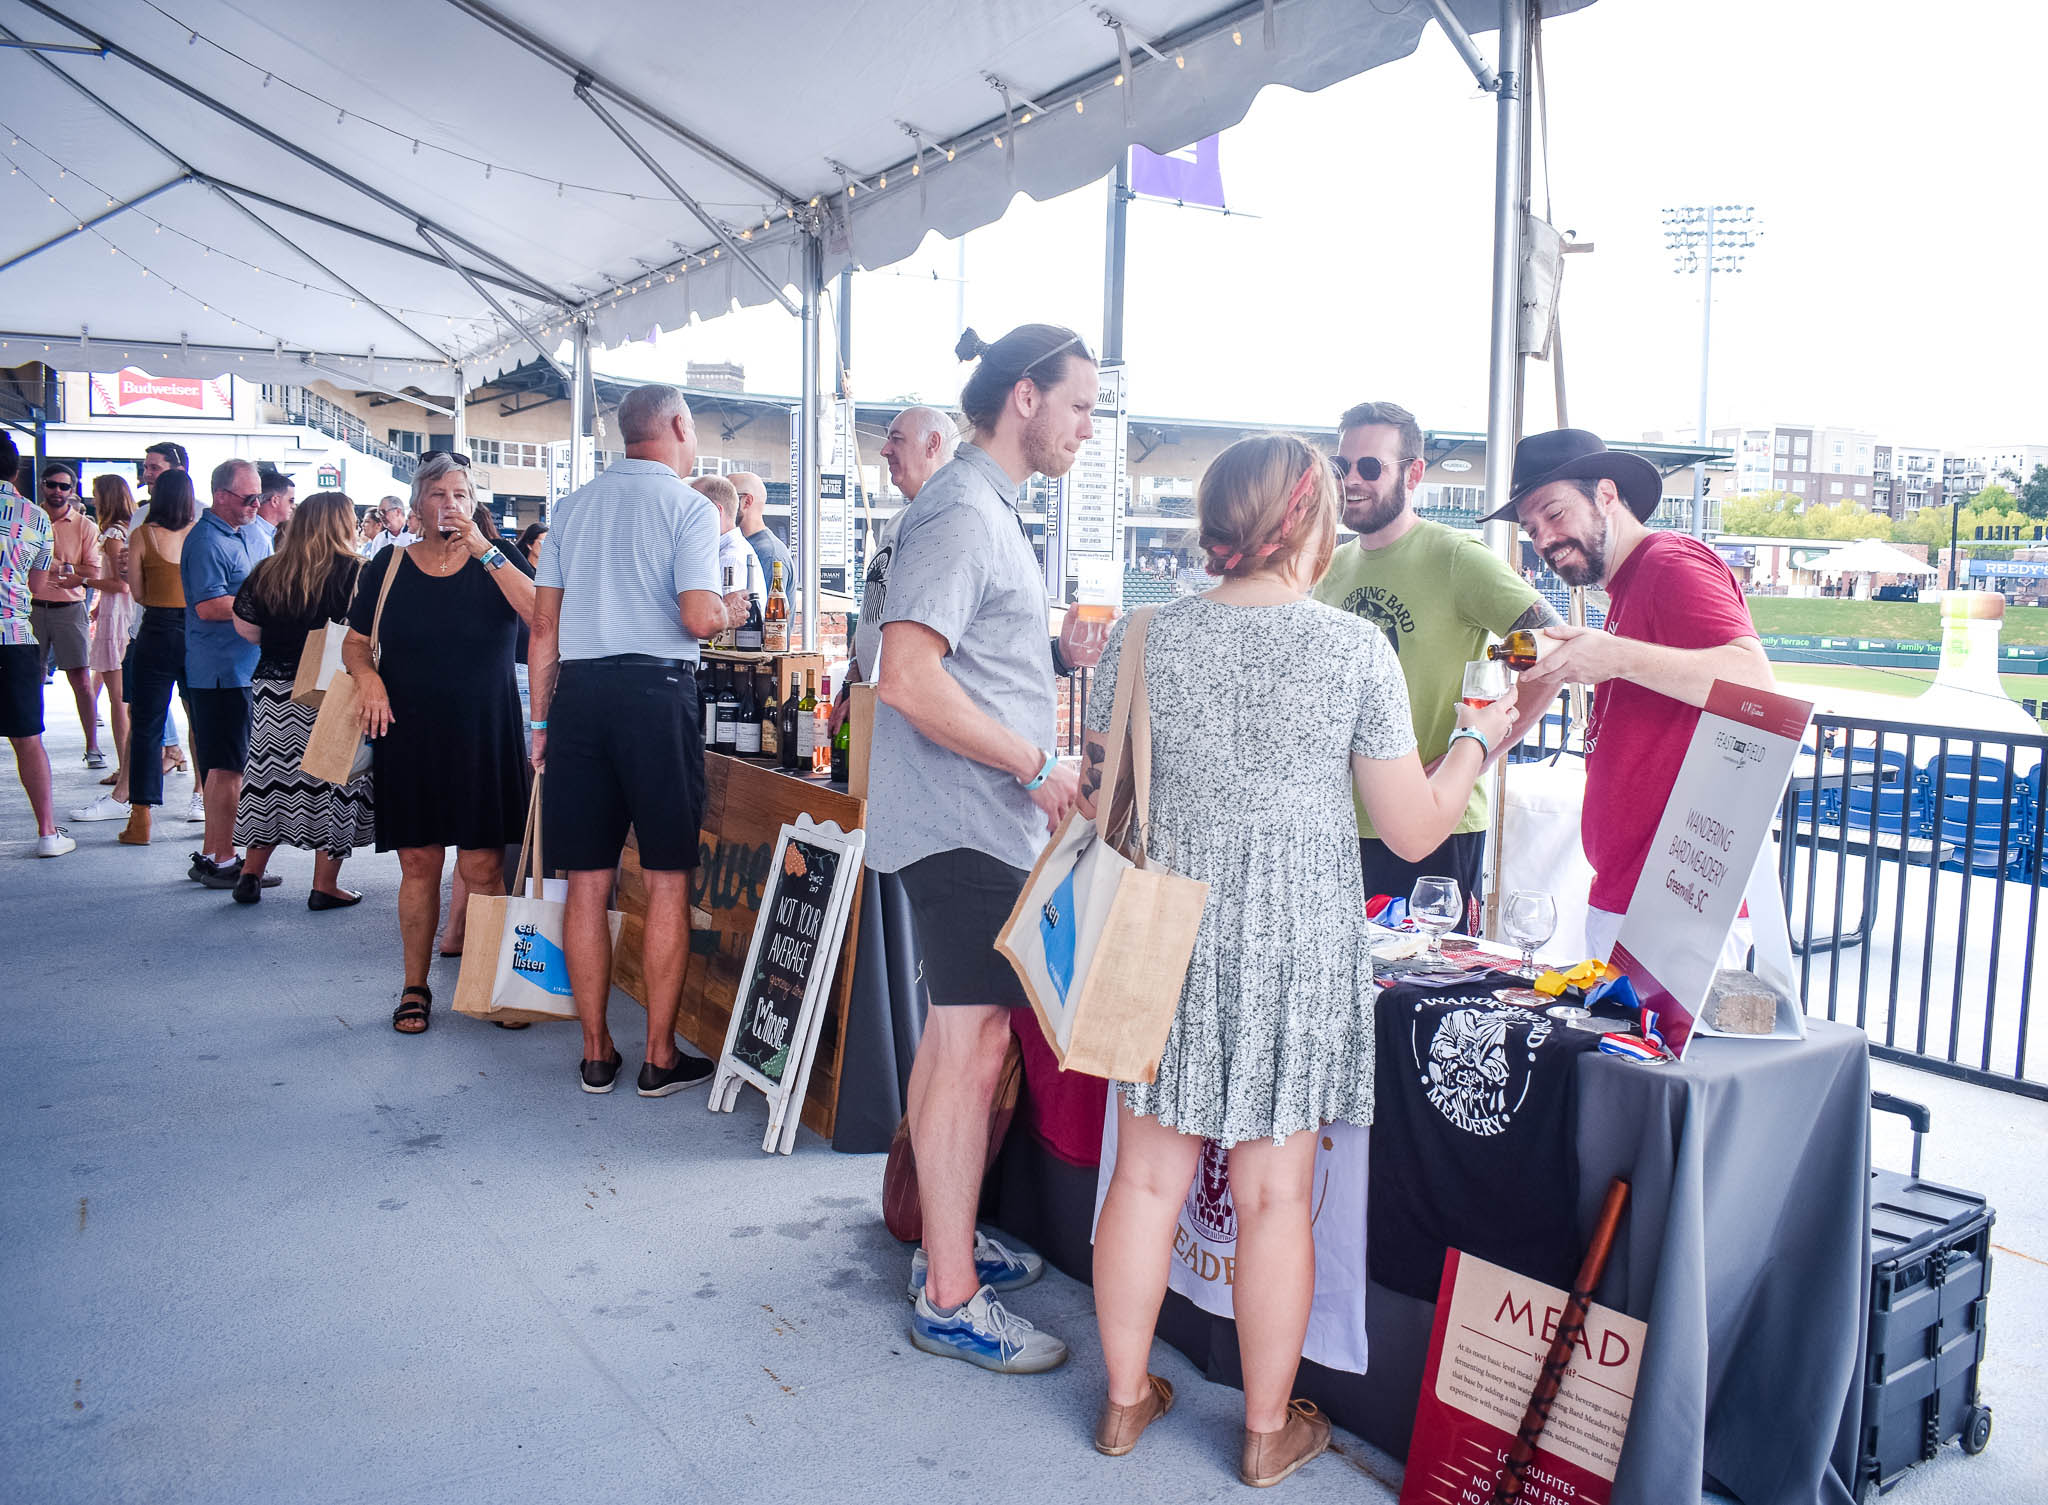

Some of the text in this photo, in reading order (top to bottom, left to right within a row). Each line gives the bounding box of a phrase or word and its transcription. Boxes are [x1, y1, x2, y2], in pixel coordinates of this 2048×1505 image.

[320, 476, 336, 486] 115
[1047, 501, 1058, 537] PRIDE
[1385, 594, 1415, 633] BARD
[1761, 637, 1810, 647] mily Terrace
[1896, 643, 1924, 653] Family
[1715, 731, 1737, 751] FEAST
[1744, 742, 1766, 763] FIELD
[1685, 807, 1735, 853] WANDERING
[1668, 834, 1729, 889] BARD MEADERY
[775, 895, 822, 941] NOT YOUR
[1694, 889, 1709, 913] SC
[517, 923, 537, 934] eat
[514, 952, 546, 971] listen
[517, 938, 533, 954] sip
[767, 932, 812, 978] AVERAGE
[1425, 1084, 1506, 1137] MEADERY
[1455, 1356, 1485, 1377] fermenting
[1485, 1369, 1503, 1384] honey
[1503, 1380, 1517, 1390] with
[1568, 1407, 1584, 1419] Bard
[1584, 1414, 1611, 1434] Meadery
[1457, 1343, 1464, 1351] At
[1472, 1350, 1487, 1361] most
[1487, 1355, 1502, 1368] basic
[1502, 1361, 1516, 1374] level
[1516, 1369, 1533, 1381] mead
[1574, 1393, 1602, 1412] beverage
[1602, 1407, 1620, 1419] made
[1620, 1413, 1629, 1425] by
[1449, 1385, 1479, 1404] experience
[1479, 1399, 1492, 1410] with
[1554, 1433, 1591, 1456] undertones,
[1590, 1450, 1604, 1461] and
[1452, 1370, 1463, 1381] that
[1463, 1376, 1476, 1387] base
[1476, 1380, 1484, 1392] by
[1484, 1386, 1504, 1401] adding
[1557, 1419, 1576, 1432] spices
[1575, 1427, 1584, 1435] to
[1583, 1430, 1610, 1448] enhance
[1462, 1488, 1481, 1504] NO
[1472, 1475, 1491, 1491] NO
[1526, 1464, 1577, 1497] SULFITES
